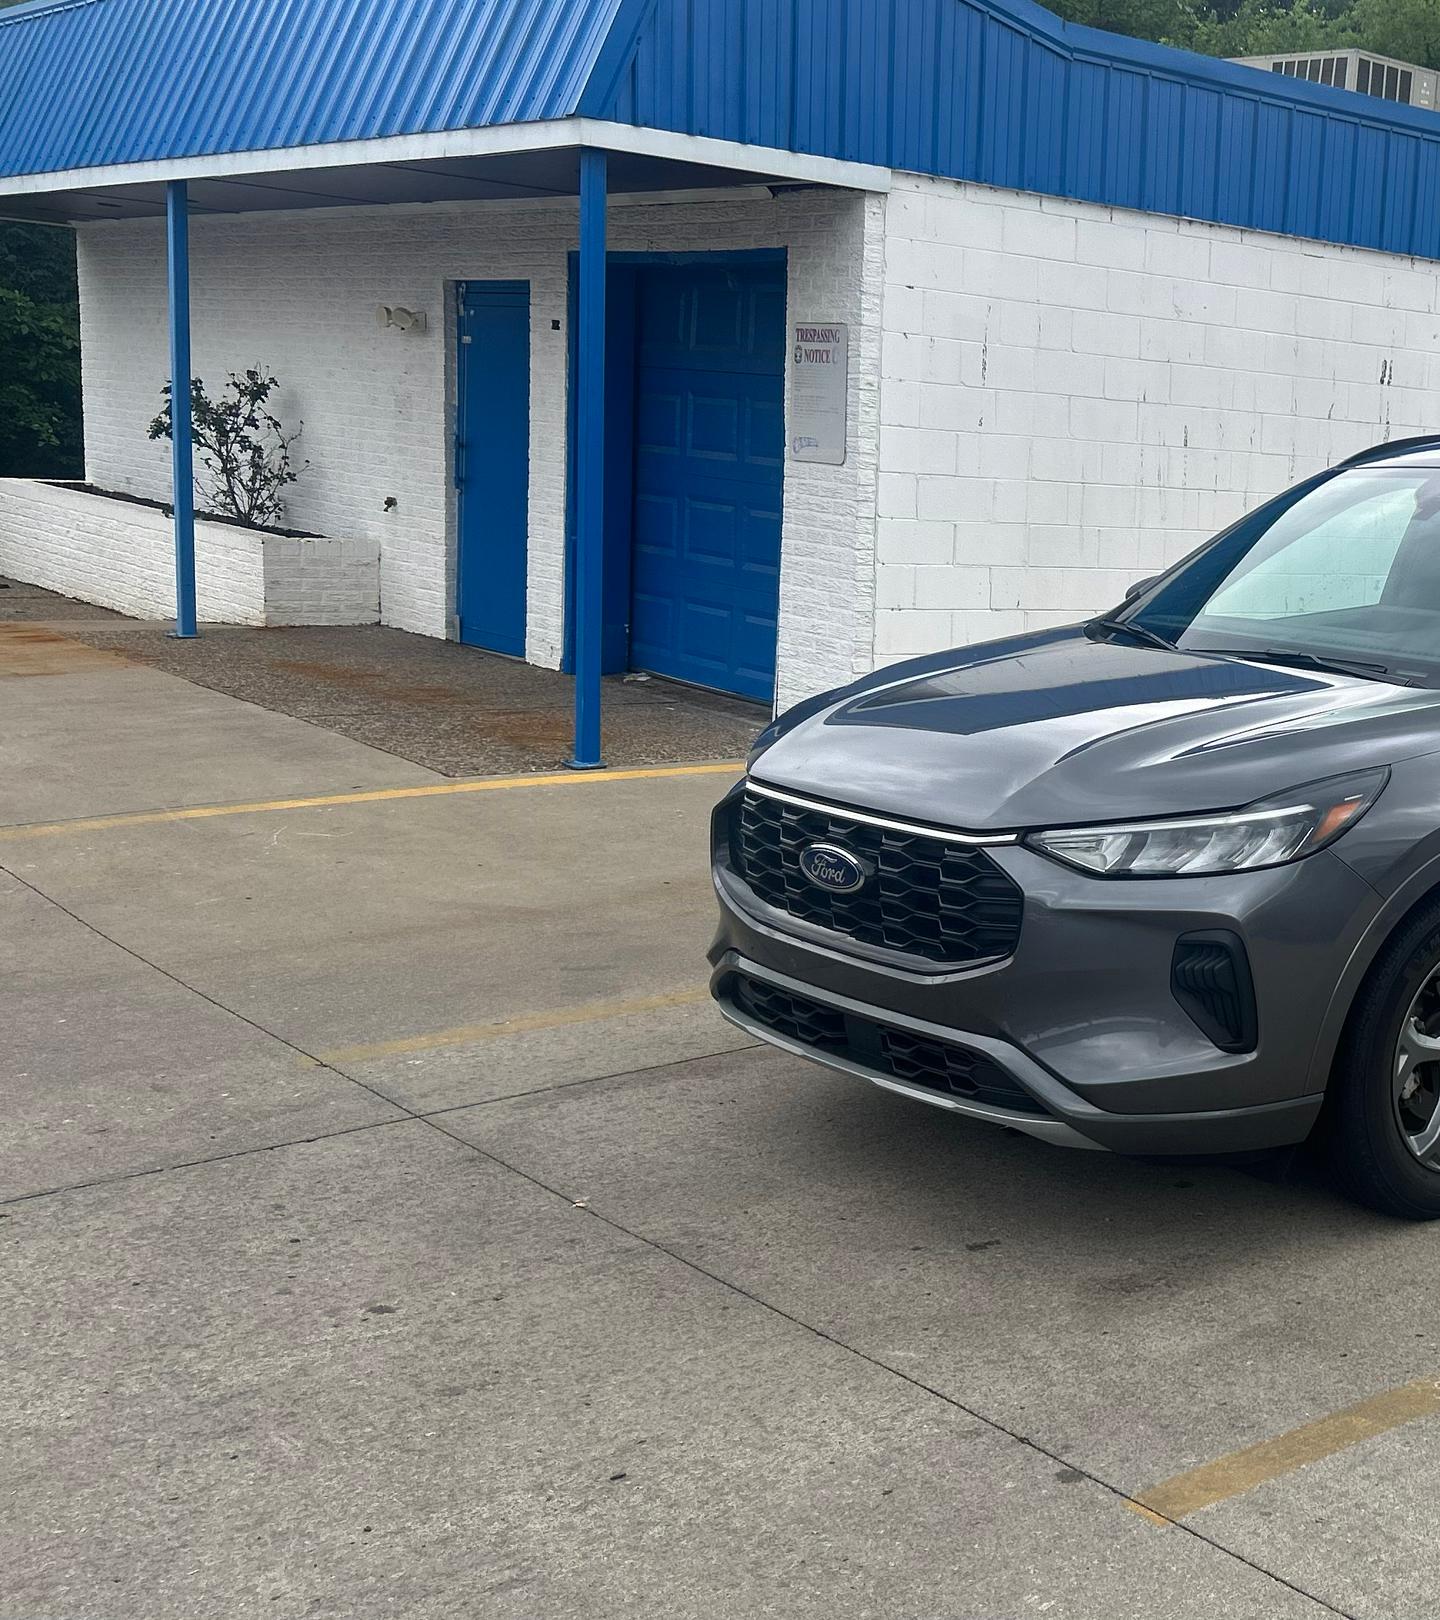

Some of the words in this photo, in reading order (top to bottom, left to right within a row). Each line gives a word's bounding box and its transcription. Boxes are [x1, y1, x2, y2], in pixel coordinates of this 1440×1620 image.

[796, 328, 840, 343] TRESPASSING
[804, 349, 831, 363] NOTICE
[811, 853, 845, 883] Ford
